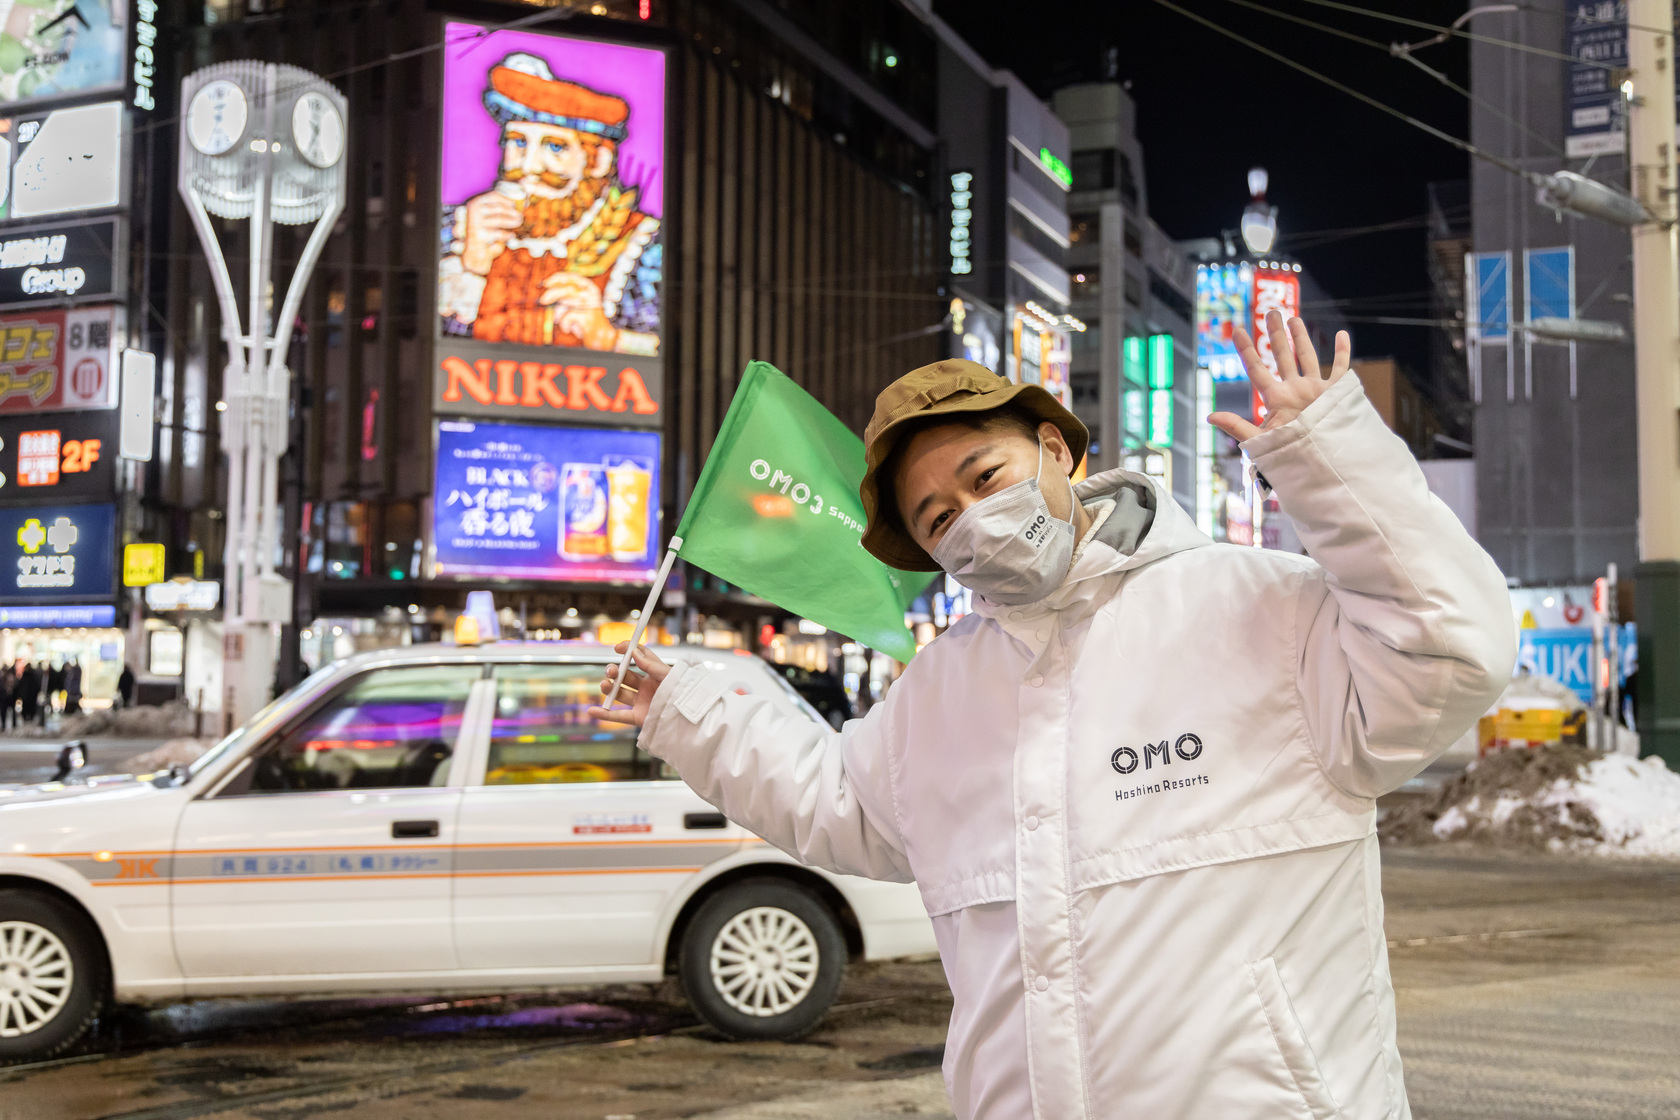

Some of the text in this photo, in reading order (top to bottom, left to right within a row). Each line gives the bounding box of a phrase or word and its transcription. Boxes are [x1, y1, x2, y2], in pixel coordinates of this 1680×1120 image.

[441, 356, 659, 415] NIKKA
[61, 439, 101, 473] 2F
[750, 459, 824, 514] OMO3
[1025, 515, 1046, 540] OMO
[1110, 732, 1203, 775] OMO
[1114, 774, 1210, 801] Hoshino Resorts
